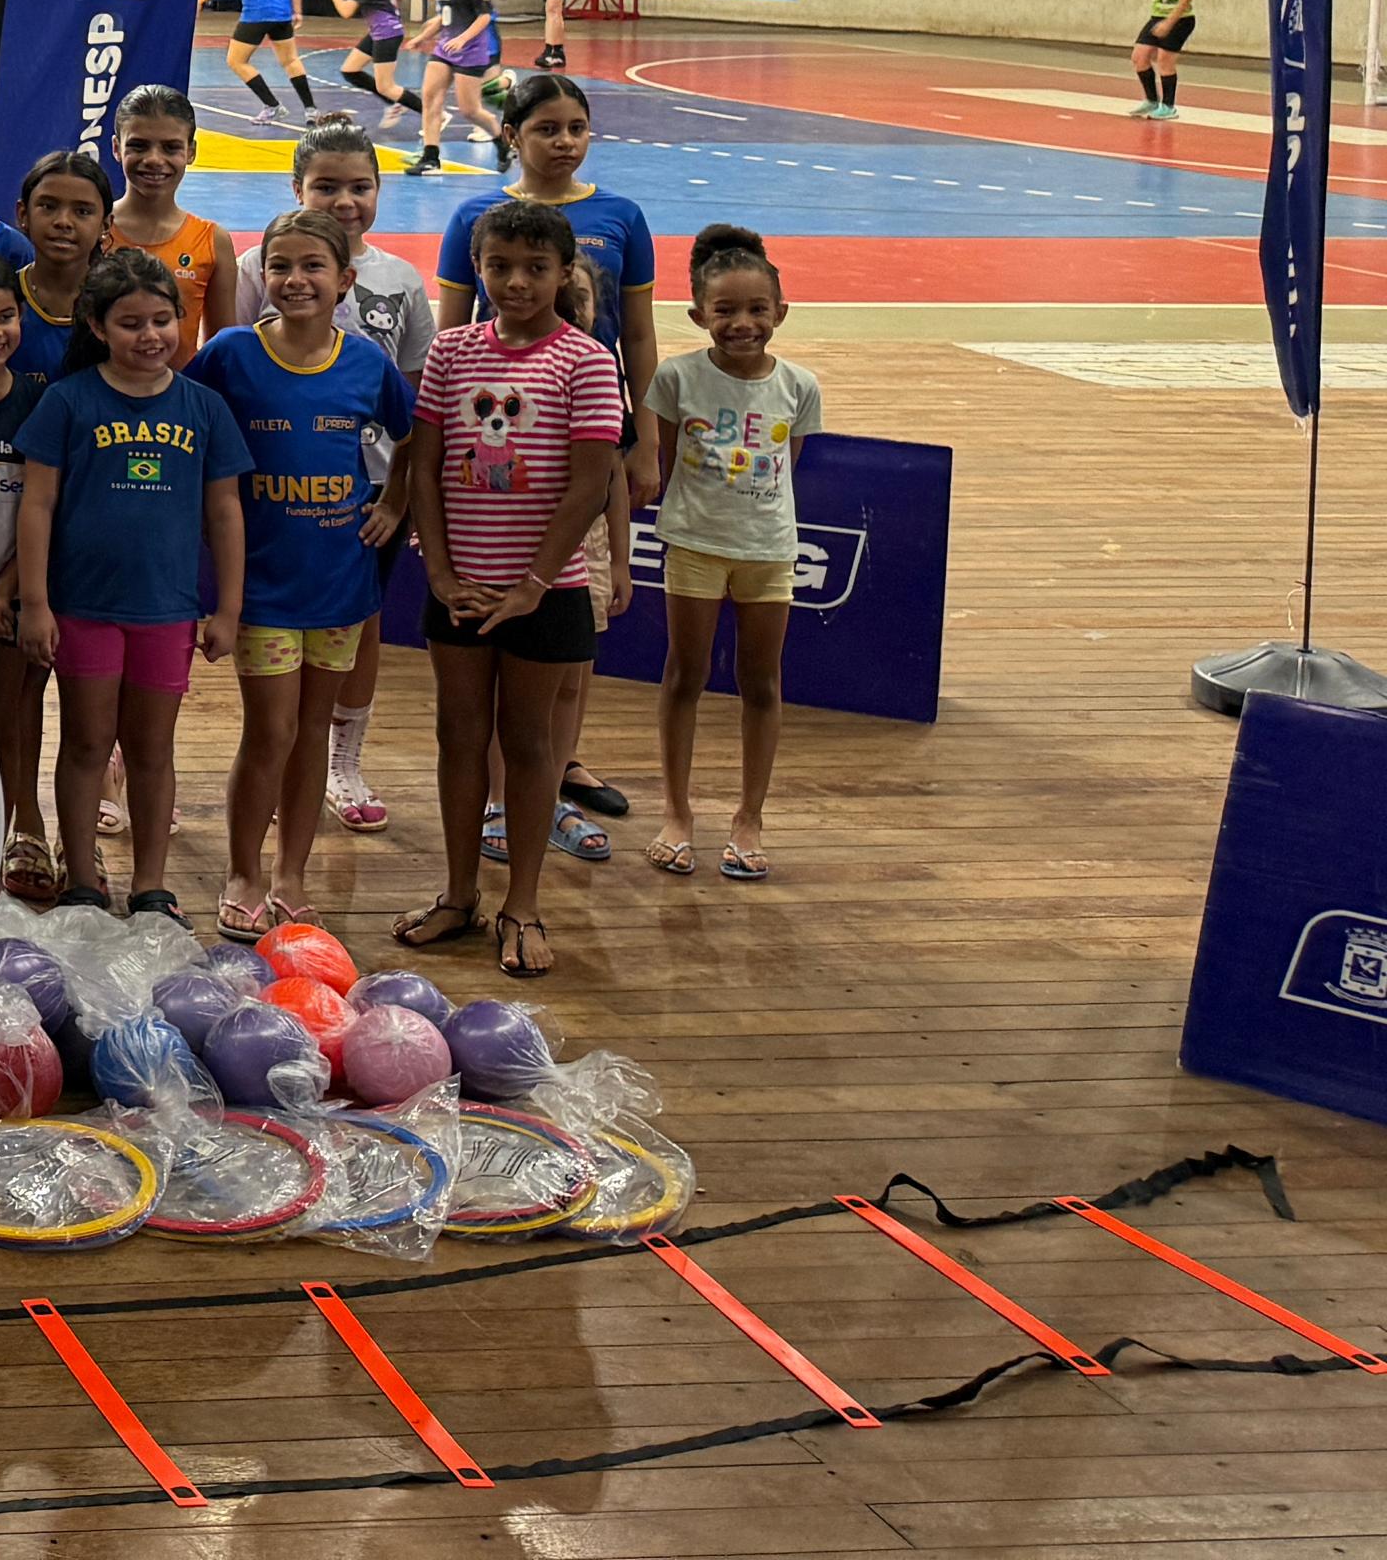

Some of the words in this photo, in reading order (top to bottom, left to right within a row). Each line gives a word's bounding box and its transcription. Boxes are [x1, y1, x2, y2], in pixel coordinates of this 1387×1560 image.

[249, 419, 292, 432] ATLETA
[716, 407, 762, 448] BE
[93, 421, 195, 454] BRASIL
[111, 482, 136, 490] SOUTH
[140, 483, 172, 492] AMERICA
[286, 506, 327, 518] Fundação
